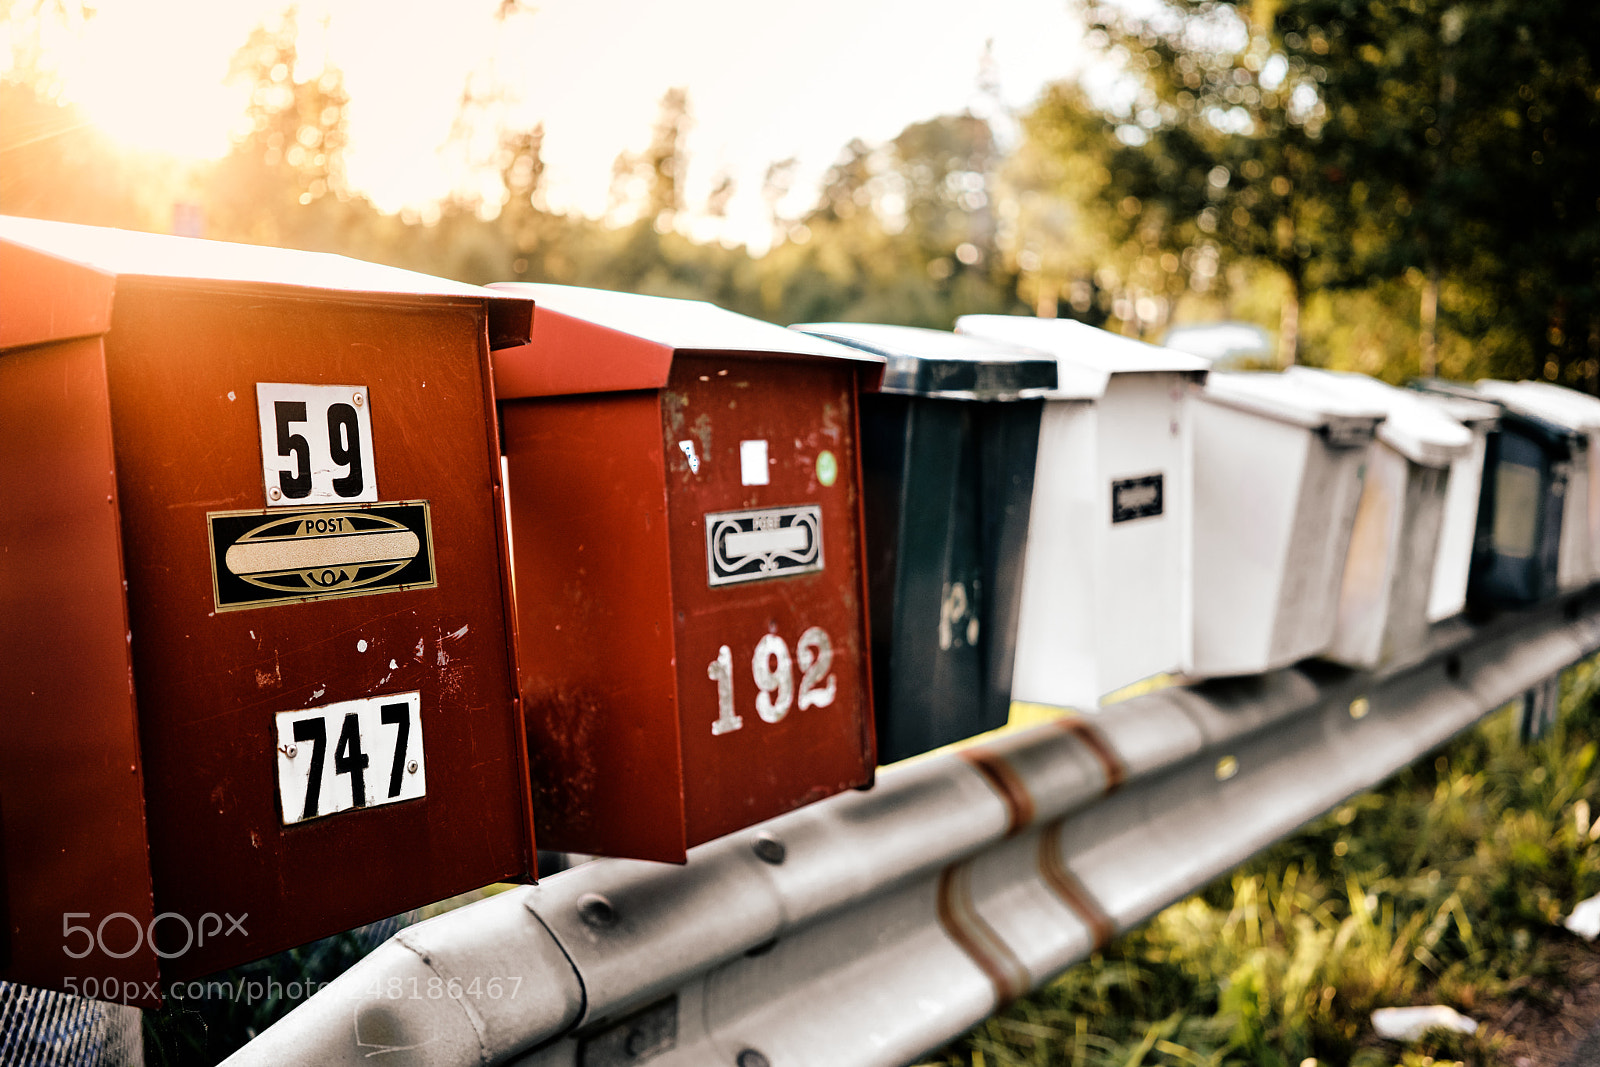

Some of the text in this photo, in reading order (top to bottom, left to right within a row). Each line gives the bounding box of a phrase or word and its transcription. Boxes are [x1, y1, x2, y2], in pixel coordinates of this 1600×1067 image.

[275, 401, 363, 498] 59
[306, 518, 344, 534] POST
[707, 625, 837, 736] 192
[293, 701, 411, 820] 747
